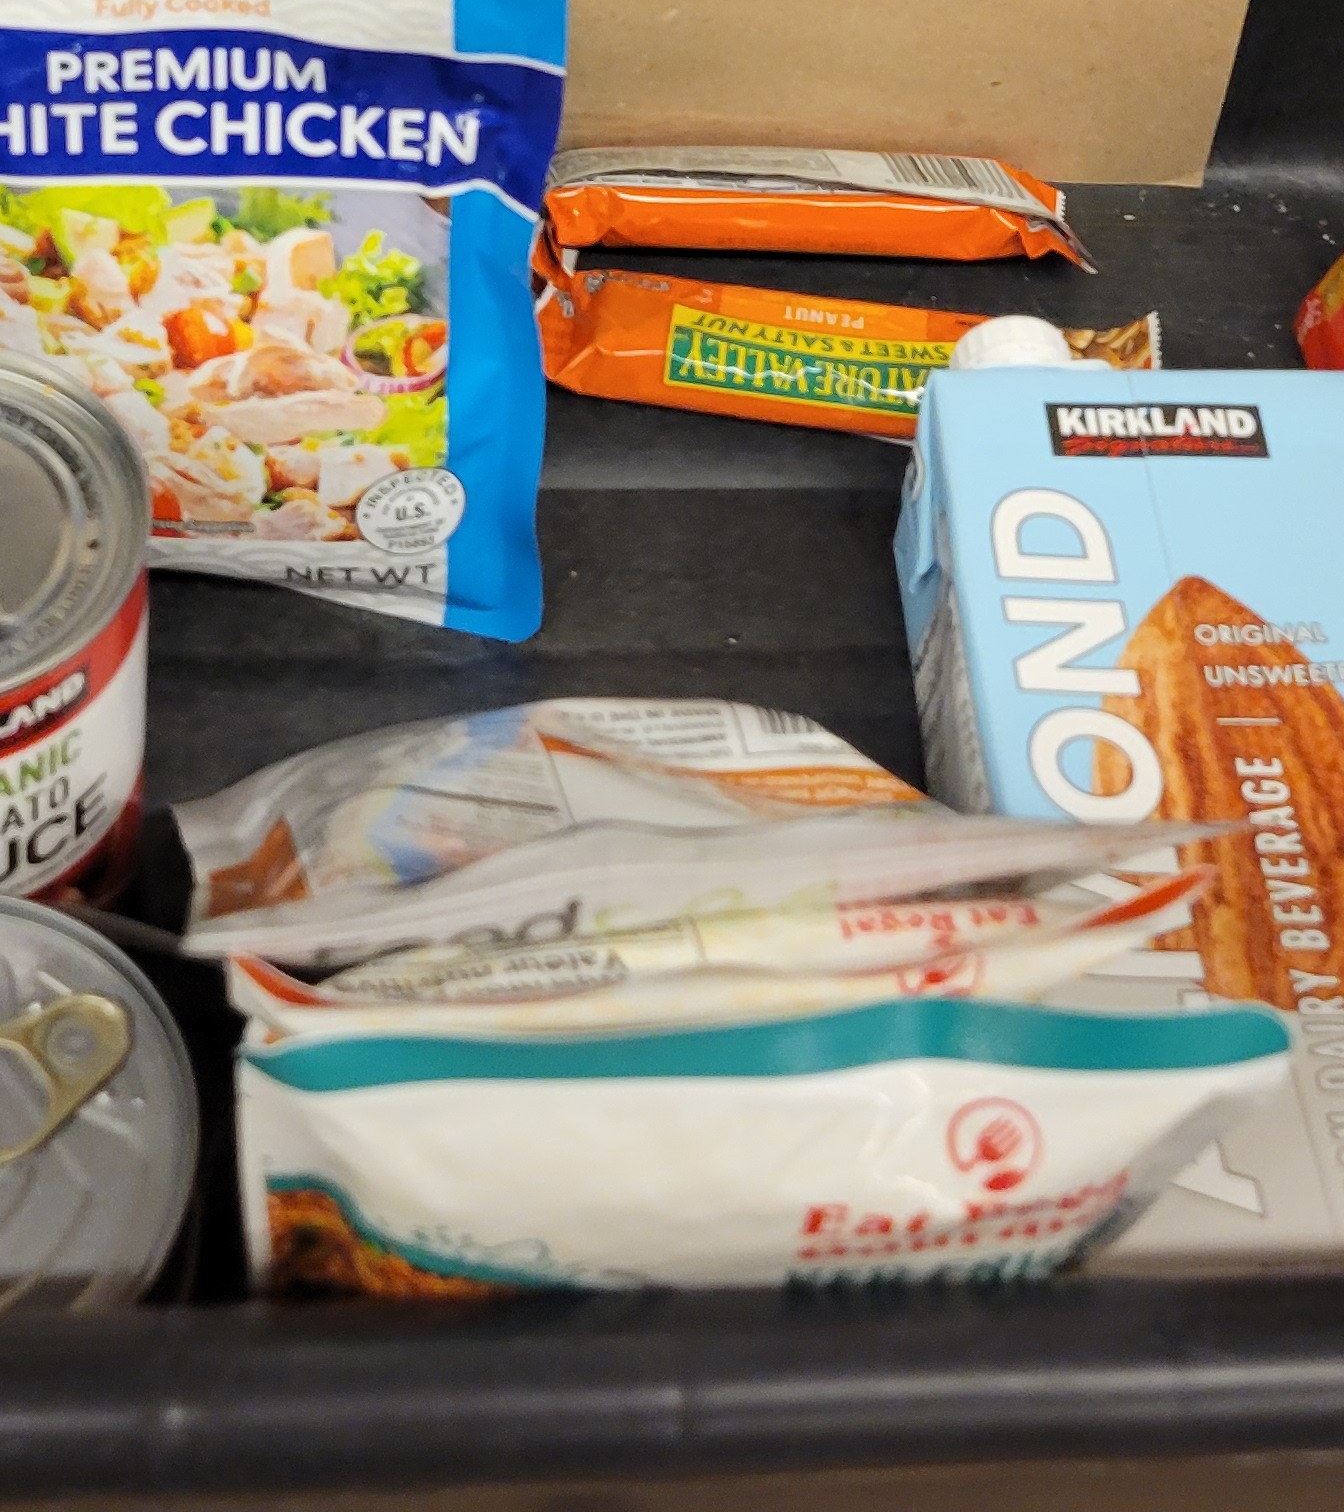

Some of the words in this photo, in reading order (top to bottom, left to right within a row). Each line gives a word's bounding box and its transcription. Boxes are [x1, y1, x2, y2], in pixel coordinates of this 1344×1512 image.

[46, 46, 327, 95] PREMIUM
[155, 100, 480, 167] CHICKEN
[690, 312, 747, 336] NUT
[785, 304, 866, 330] PEANUT
[757, 322, 834, 353] SALTY
[859, 341, 950, 362] SWEET
[678, 329, 810, 394] VALLEY
[814, 358, 931, 408] ATURE
[1056, 406, 1257, 439] KIRKLAND
[284, 565, 359, 585] NET
[370, 563, 437, 586] WT
[1193, 621, 1328, 647] ORIGINAL
[1234, 755, 1330, 951] BEVERAGE
